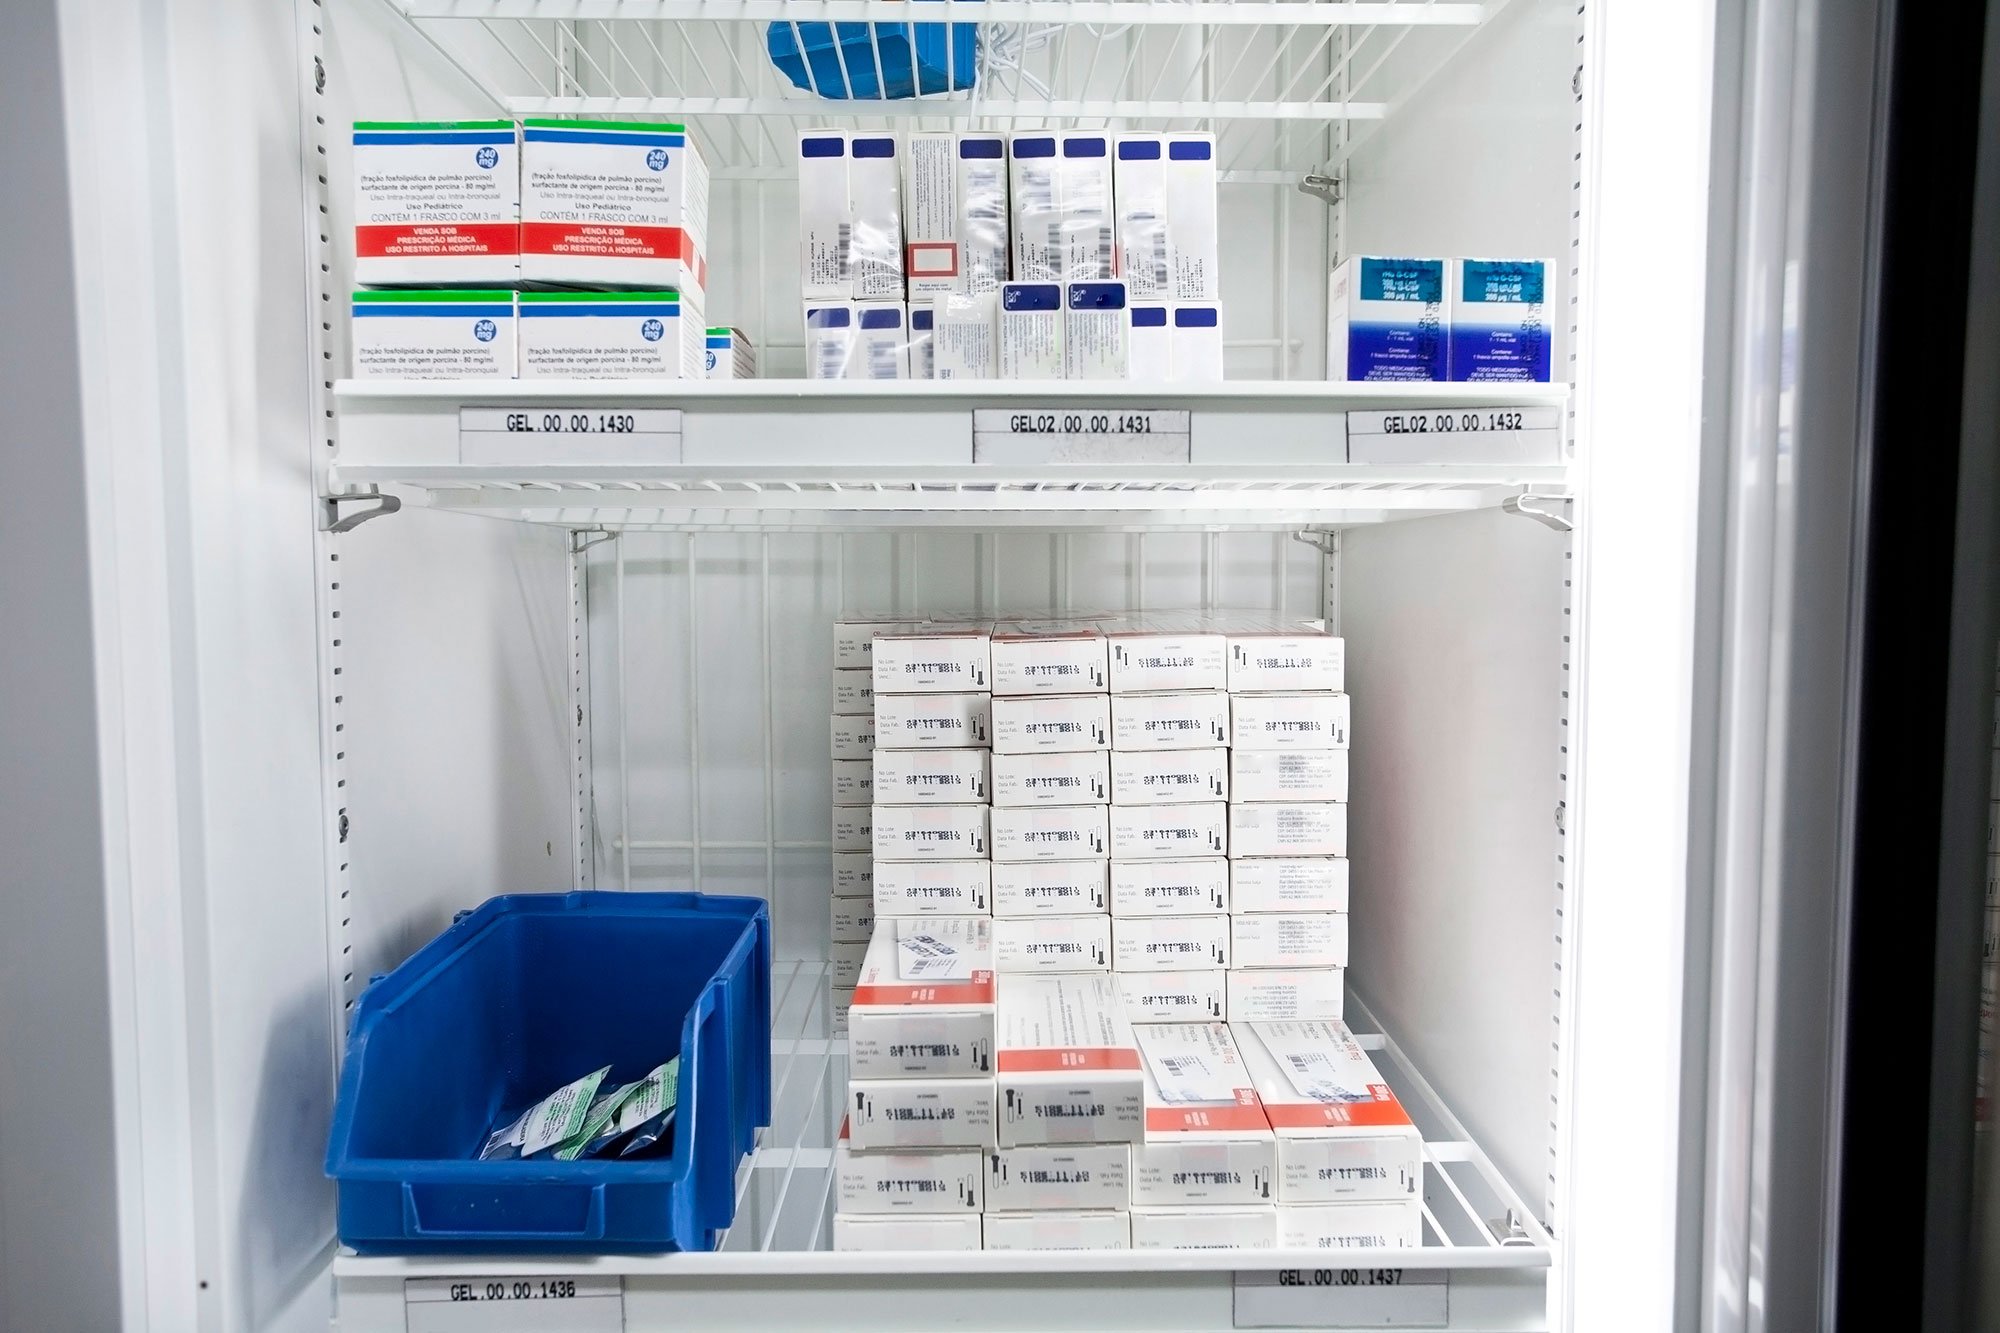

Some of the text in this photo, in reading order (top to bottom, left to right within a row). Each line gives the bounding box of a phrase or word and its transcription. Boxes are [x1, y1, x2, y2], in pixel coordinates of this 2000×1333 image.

[478, 150, 496, 158] 240
[649, 152, 666, 160] 240
[479, 158, 494, 168] mg
[650, 160, 664, 170] mg
[464, 174, 492, 182] porcino)
[475, 183, 496, 191] mg/ml
[371, 212, 410, 222] CONTÉM
[420, 213, 458, 221] FRASCO
[460, 212, 481, 221] COM
[491, 212, 501, 220] ml
[540, 211, 579, 221] CONTÉM
[589, 213, 626, 222] FRASCO
[628, 214, 649, 223] COM
[658, 215, 668, 223] ml
[397, 236, 445, 245] PRESCRIÇÃO
[565, 236, 643, 245] PRESCRIÇÃO MÉDICA
[477, 322, 494, 331] 240
[644, 322, 661, 331] 240
[477, 332, 492, 340] mg
[644, 331, 659, 340] mg
[507, 414, 634, 433] GEL.00.00.1430
[1010, 415, 1151, 433] GEL02.00.00.1431
[1384, 413, 1522, 433] GEL02.00.00.1432
[1279, 1269, 1402, 1286] GEL.00.00.1437
[450, 1280, 576, 1301] GEL.00.00.1436
